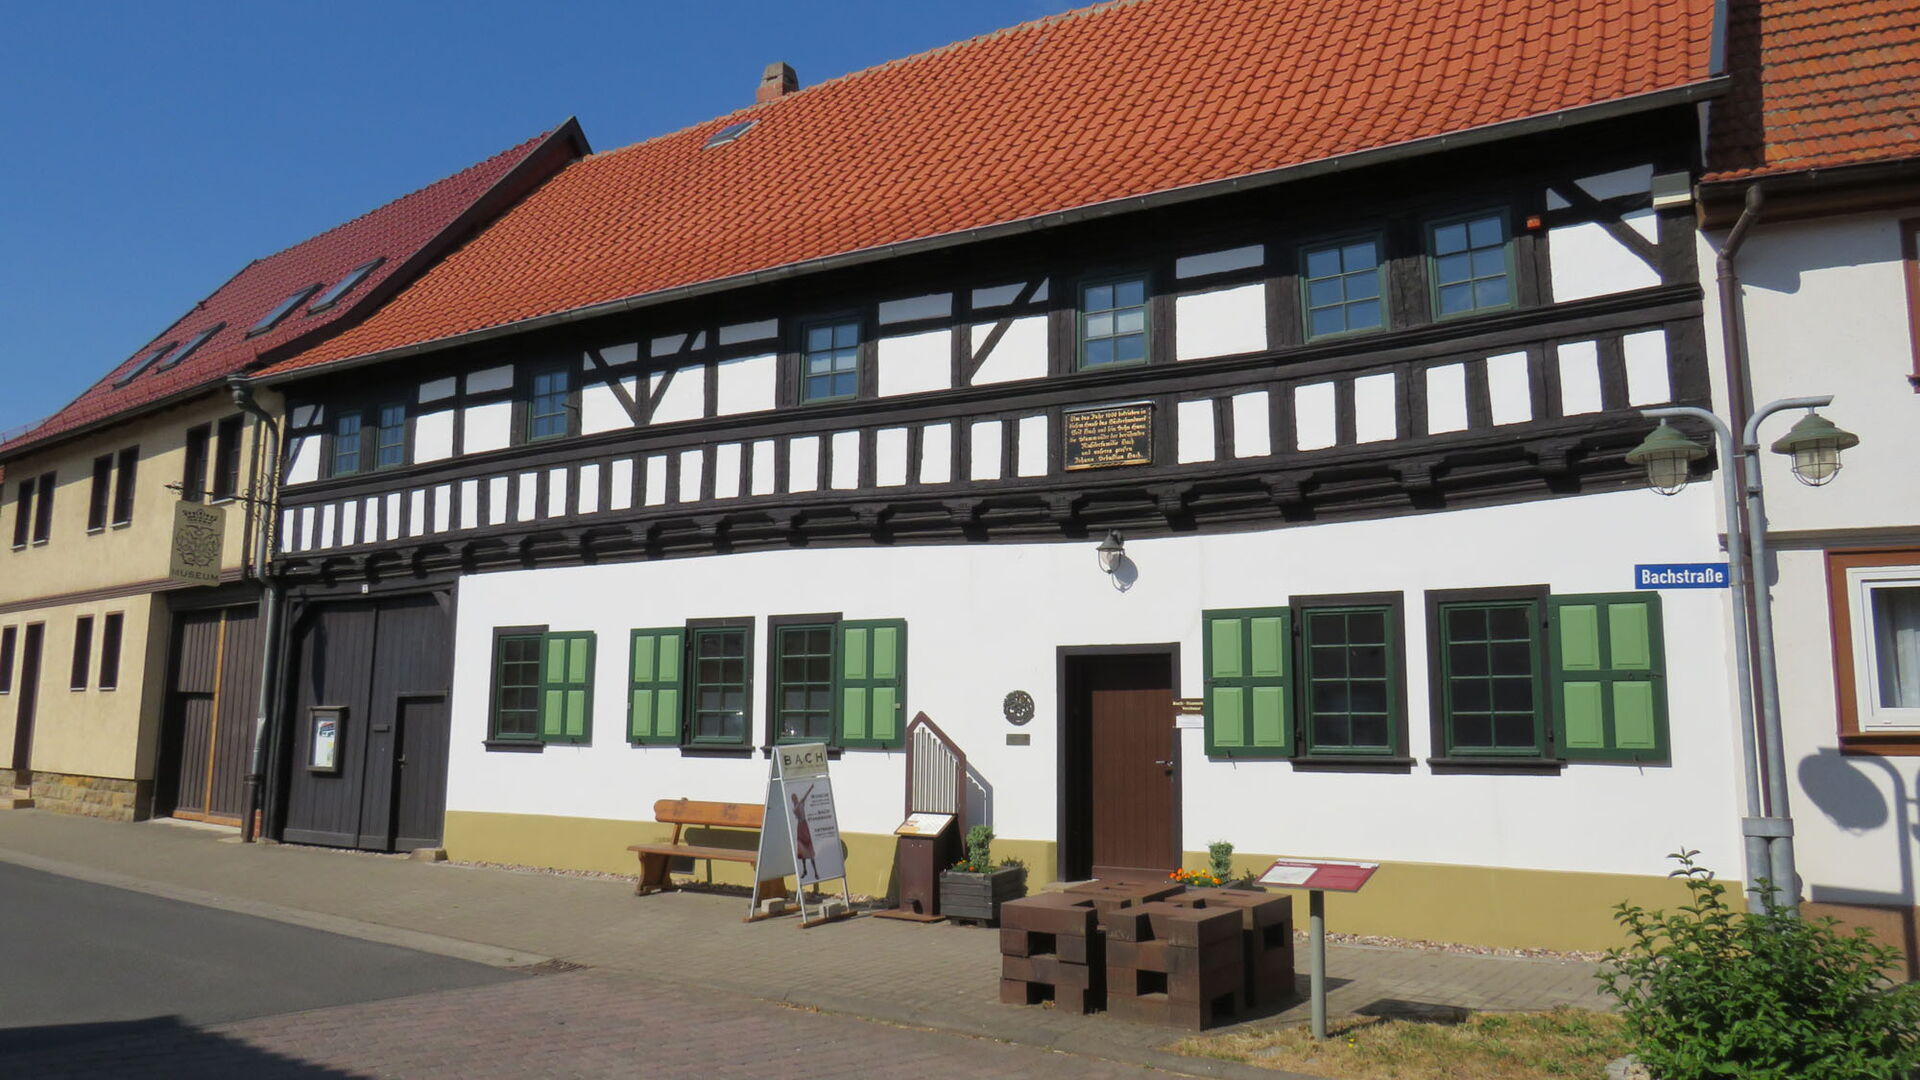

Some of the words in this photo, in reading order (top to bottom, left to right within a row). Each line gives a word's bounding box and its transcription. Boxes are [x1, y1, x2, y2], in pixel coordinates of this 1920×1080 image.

[1122, 438, 1135, 446] Bach
[172, 568, 219, 581] MUSEUM
[1642, 568, 1723, 584] Bachstraße
[784, 752, 823, 765] BACH
